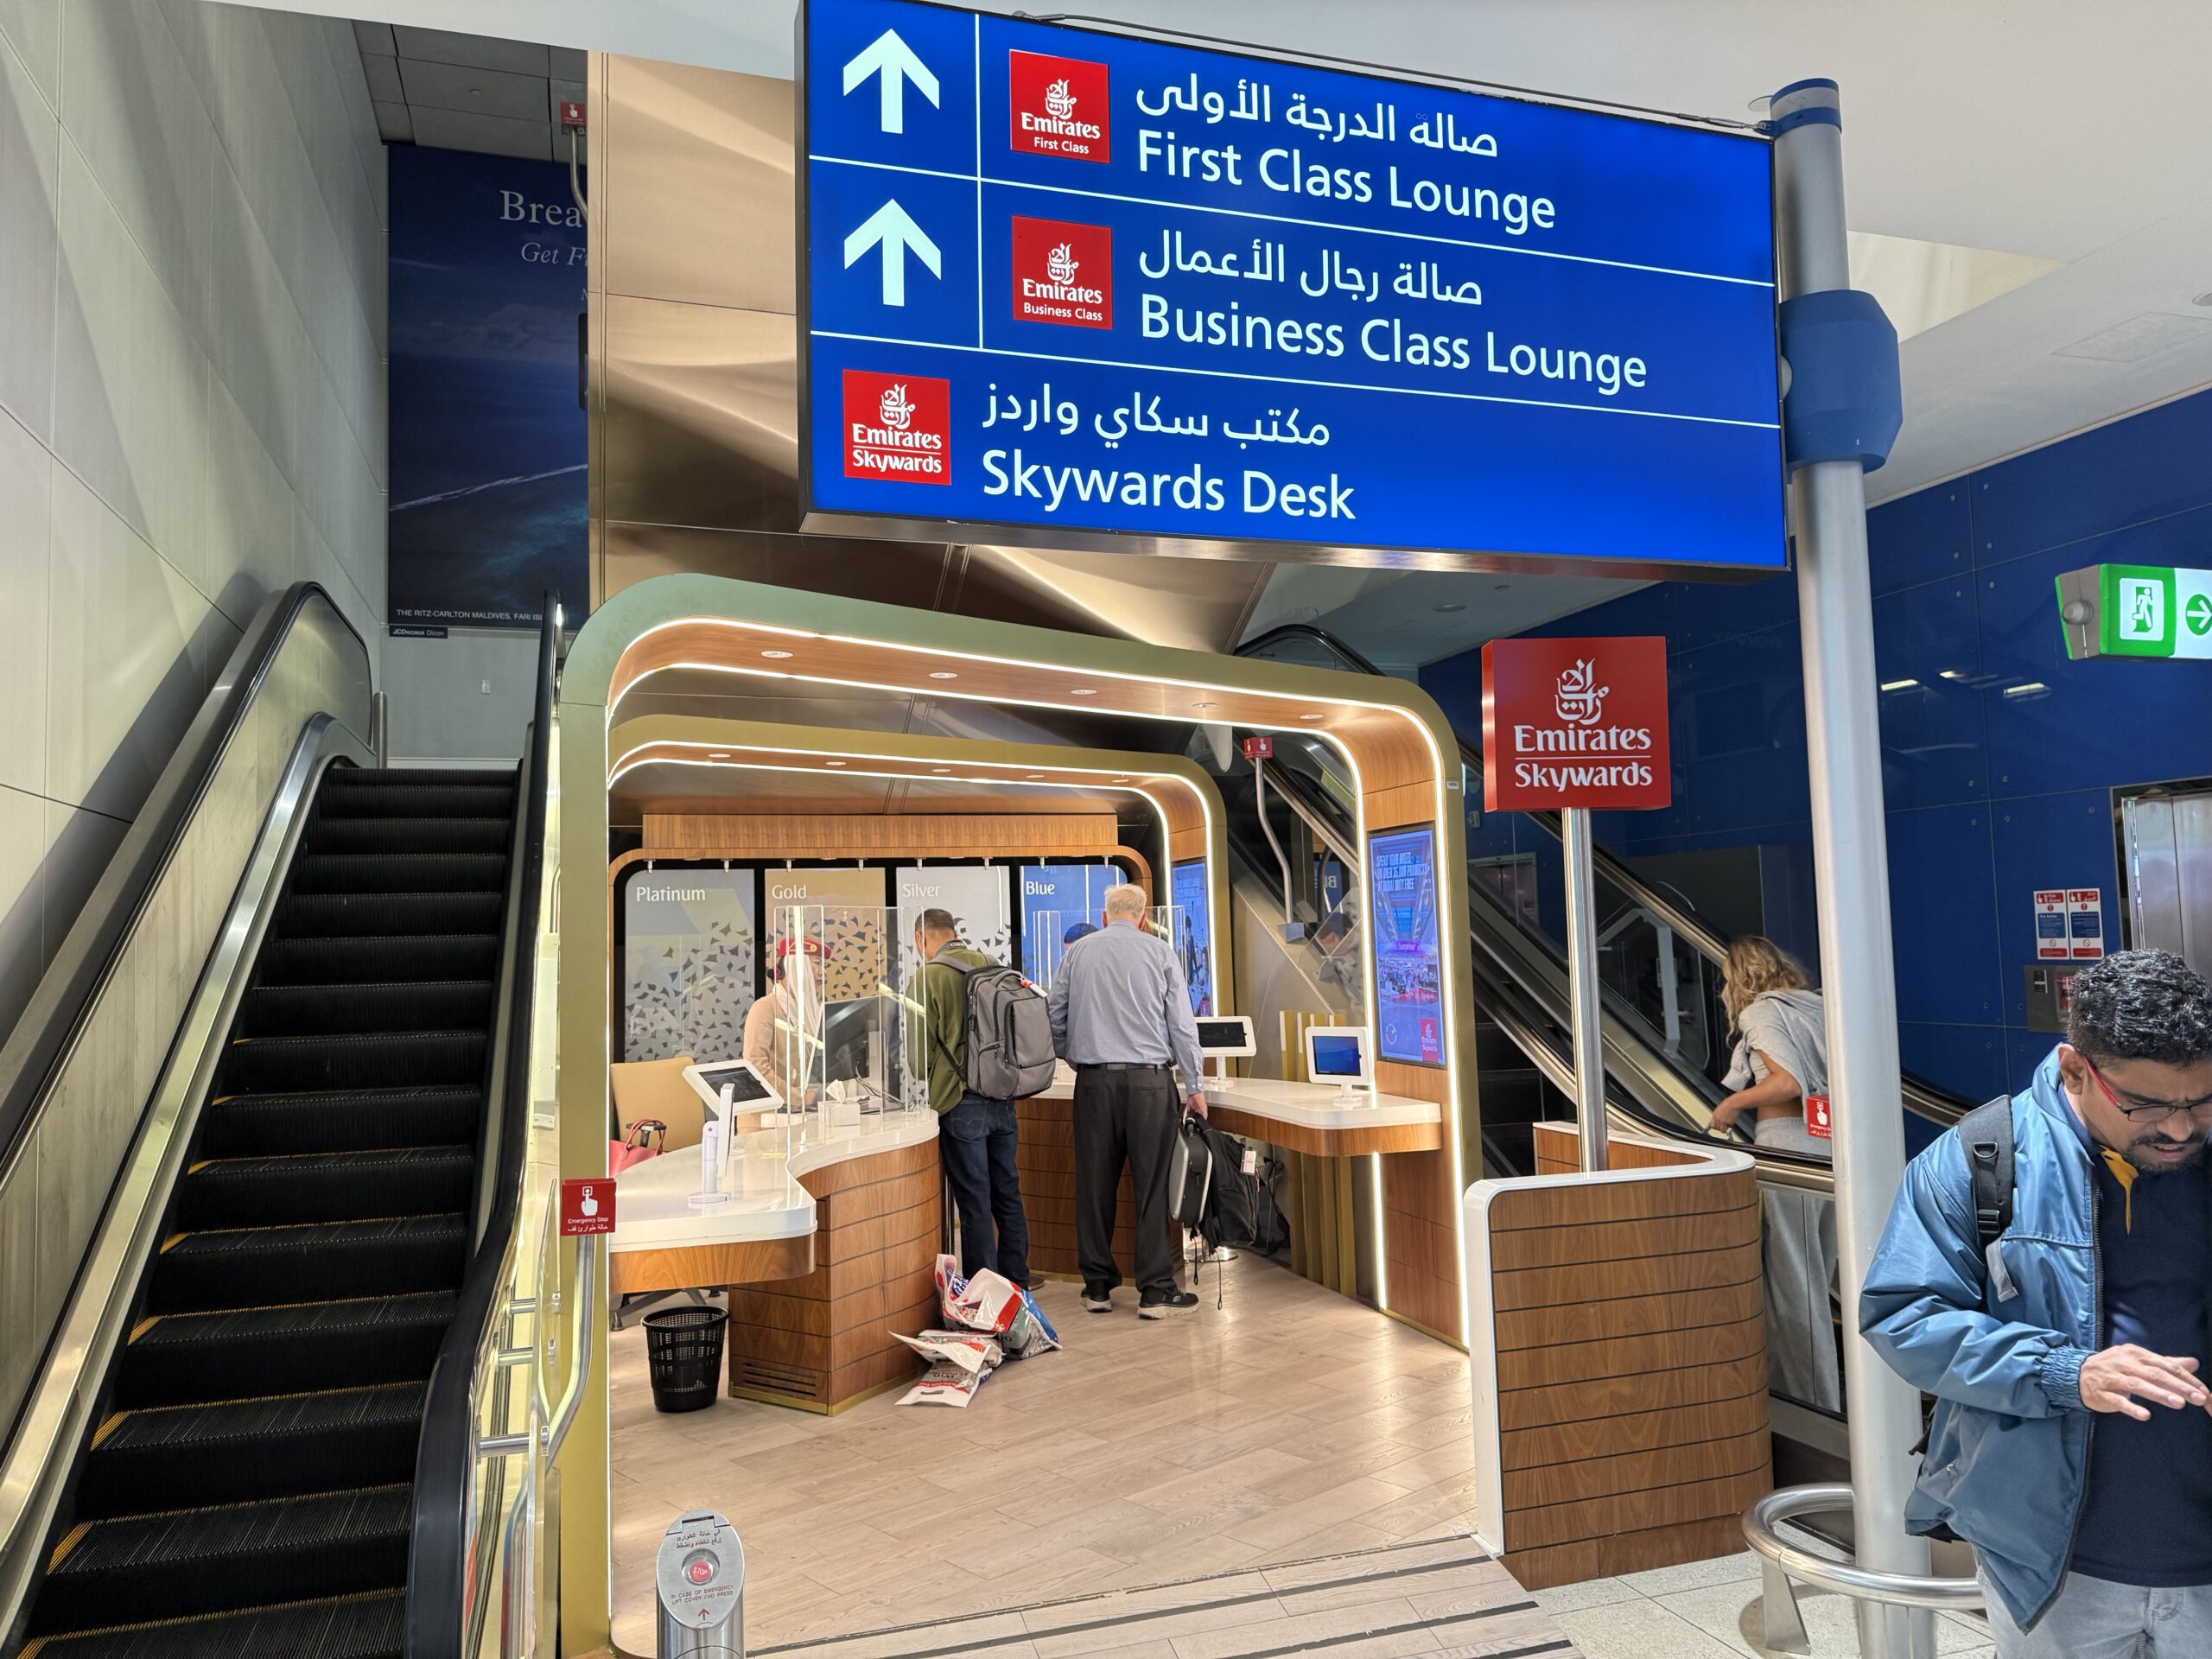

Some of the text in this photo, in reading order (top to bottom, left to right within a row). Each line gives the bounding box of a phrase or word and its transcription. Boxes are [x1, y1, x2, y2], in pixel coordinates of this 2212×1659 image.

[1137, 73, 1270, 124] الأولى
[1021, 112, 1100, 139] Emirates
[1287, 93, 1395, 142] الدرجة
[1034, 137, 1089, 154] First Class
[1140, 130, 1554, 234] First Class Lounge
[521, 242, 560, 264] Get
[1140, 230, 1481, 304] صالة رجال الأعمال
[1023, 278, 1103, 304] Emirates
[1024, 302, 1103, 321] Business Class
[1142, 294, 1646, 395] Business Class Lounge
[982, 384, 1329, 448] مكتب سكاي واردز
[852, 423, 942, 449] Emirates
[853, 449, 942, 473] Skywards
[983, 449, 1356, 518] Skywards Desk
[397, 608, 412, 617] THE
[414, 610, 470, 619] RITZ-CARLTON
[472, 612, 512, 620] MALDIVES,
[1514, 723, 1650, 751] Emirates
[1516, 762, 1652, 791] Skywards
[636, 887, 706, 902] Platinum
[772, 884, 807, 899] Gold
[902, 883, 941, 898] Silver
[1026, 881, 1055, 895] Blue
[693, 1567, 709, 1575] STOP
[704, 1585, 733, 1593] EMERGENCY
